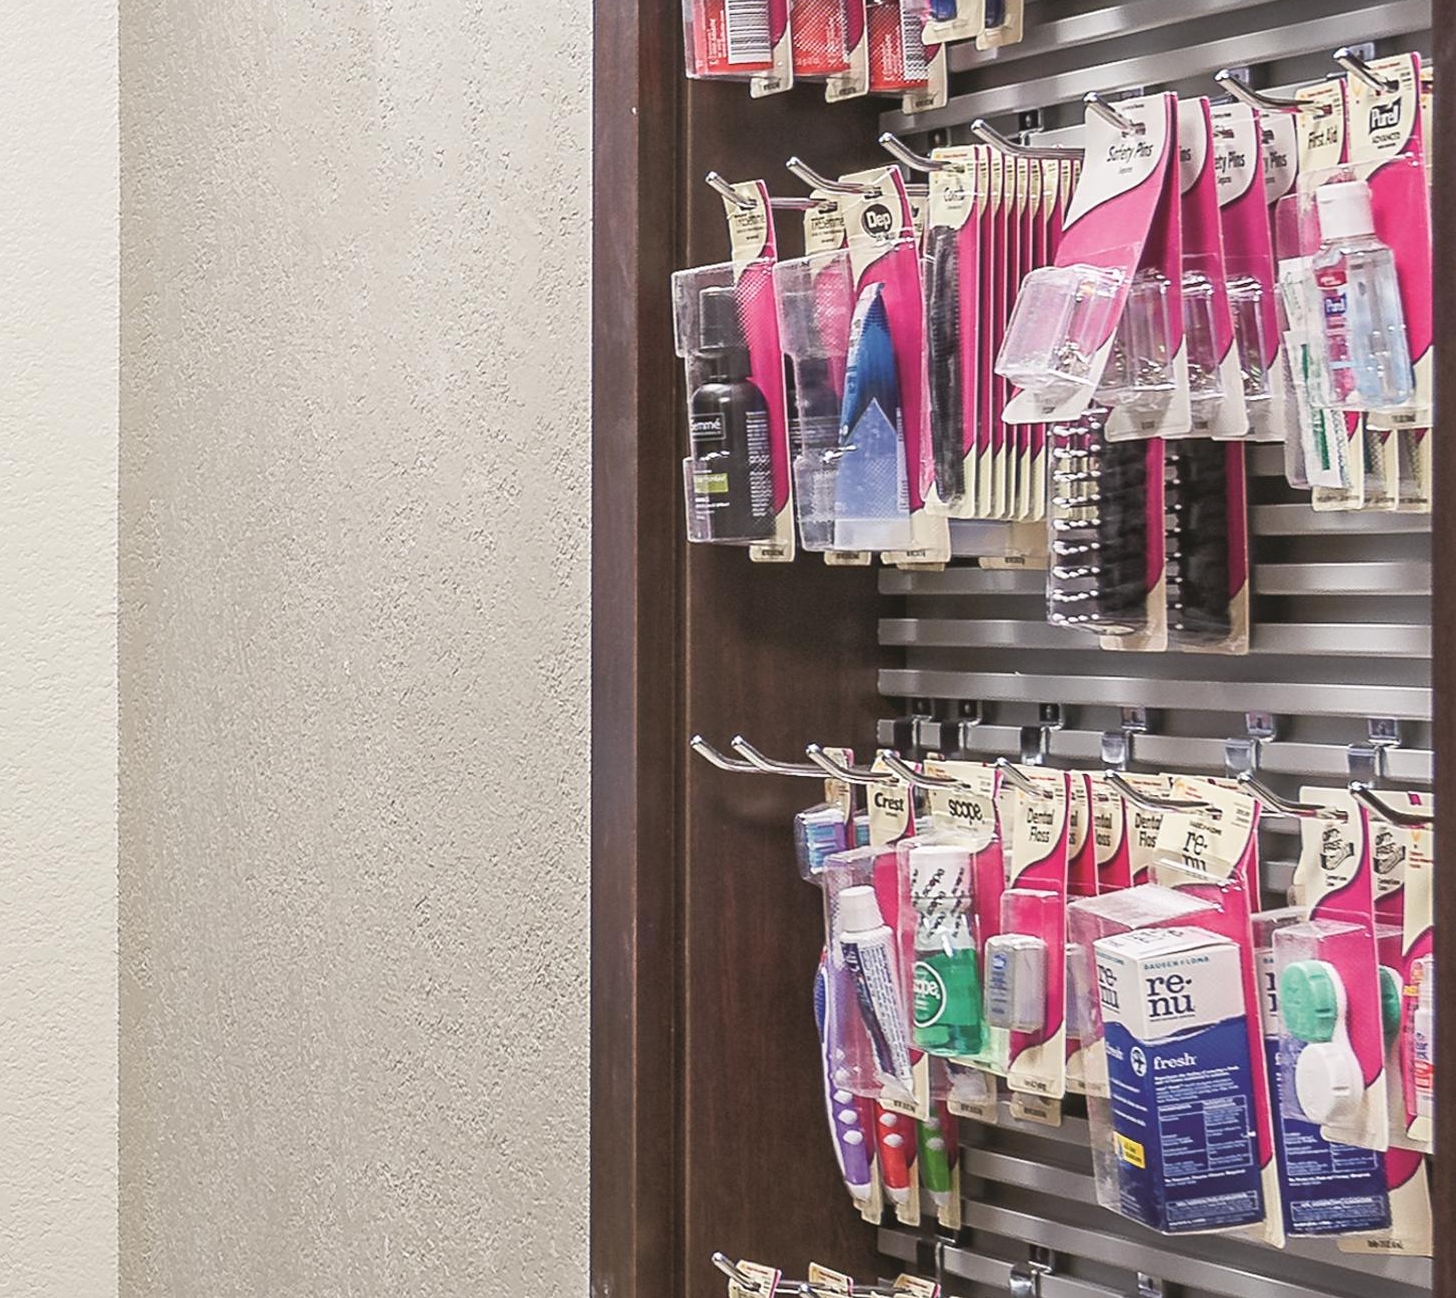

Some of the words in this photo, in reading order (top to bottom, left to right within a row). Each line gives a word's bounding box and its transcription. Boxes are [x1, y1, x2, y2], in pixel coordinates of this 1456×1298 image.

[1106, 146, 1134, 163] Safety
[1136, 143, 1154, 158] Pins
[868, 212, 891, 230] Dep
[874, 792, 904, 812] Crest
[949, 799, 983, 822] scope
[1026, 808, 1053, 826] Dental
[1029, 825, 1050, 843] Floss
[1148, 994, 1195, 1018] nu
[1153, 1053, 1193, 1070] fresh
